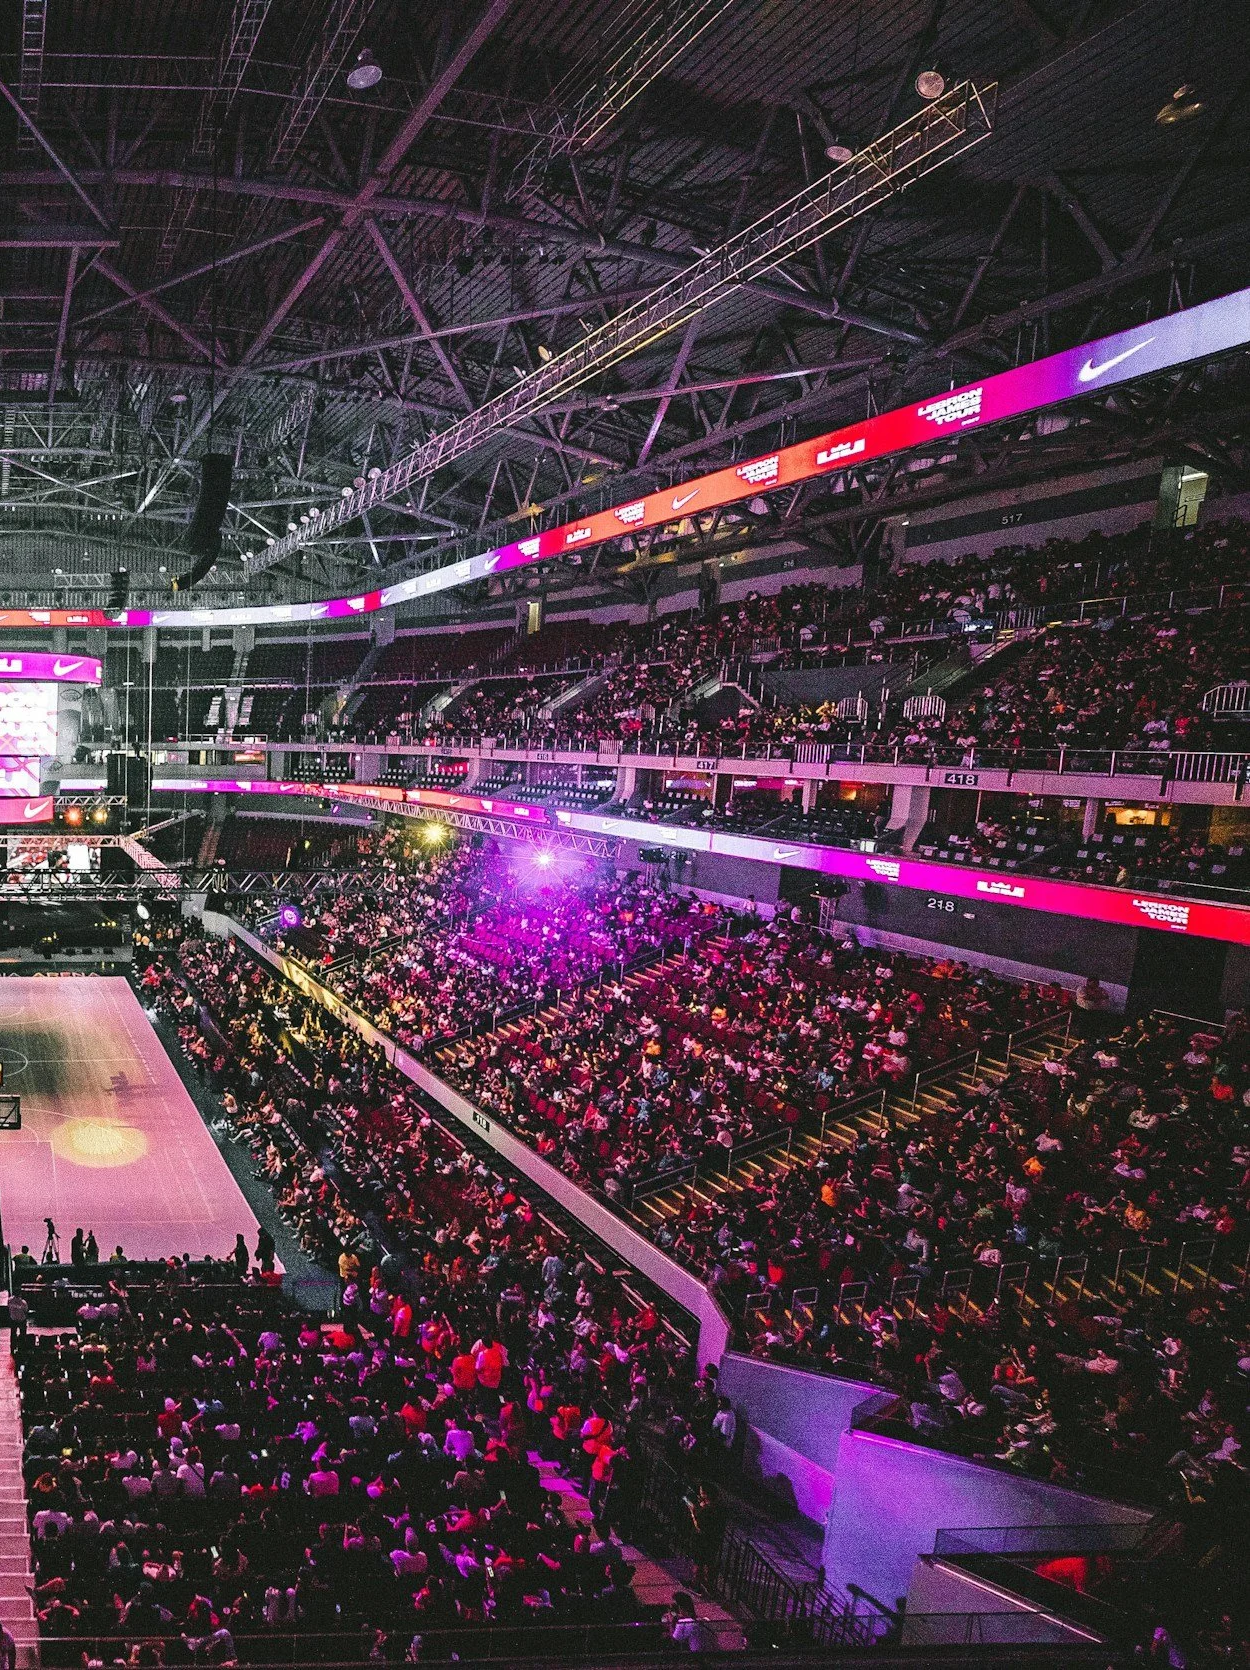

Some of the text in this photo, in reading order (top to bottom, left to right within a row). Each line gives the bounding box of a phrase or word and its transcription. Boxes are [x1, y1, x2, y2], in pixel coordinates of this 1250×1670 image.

[918, 387, 983, 416] LEBRON
[926, 395, 983, 421] JAMES
[935, 404, 981, 425] TOUR
[1002, 513, 1023, 524] 517
[947, 774, 975, 786] 418
[927, 898, 954, 911] 218
[1133, 899, 1189, 913] LEBRON
[1148, 912, 1188, 925] TOUR
